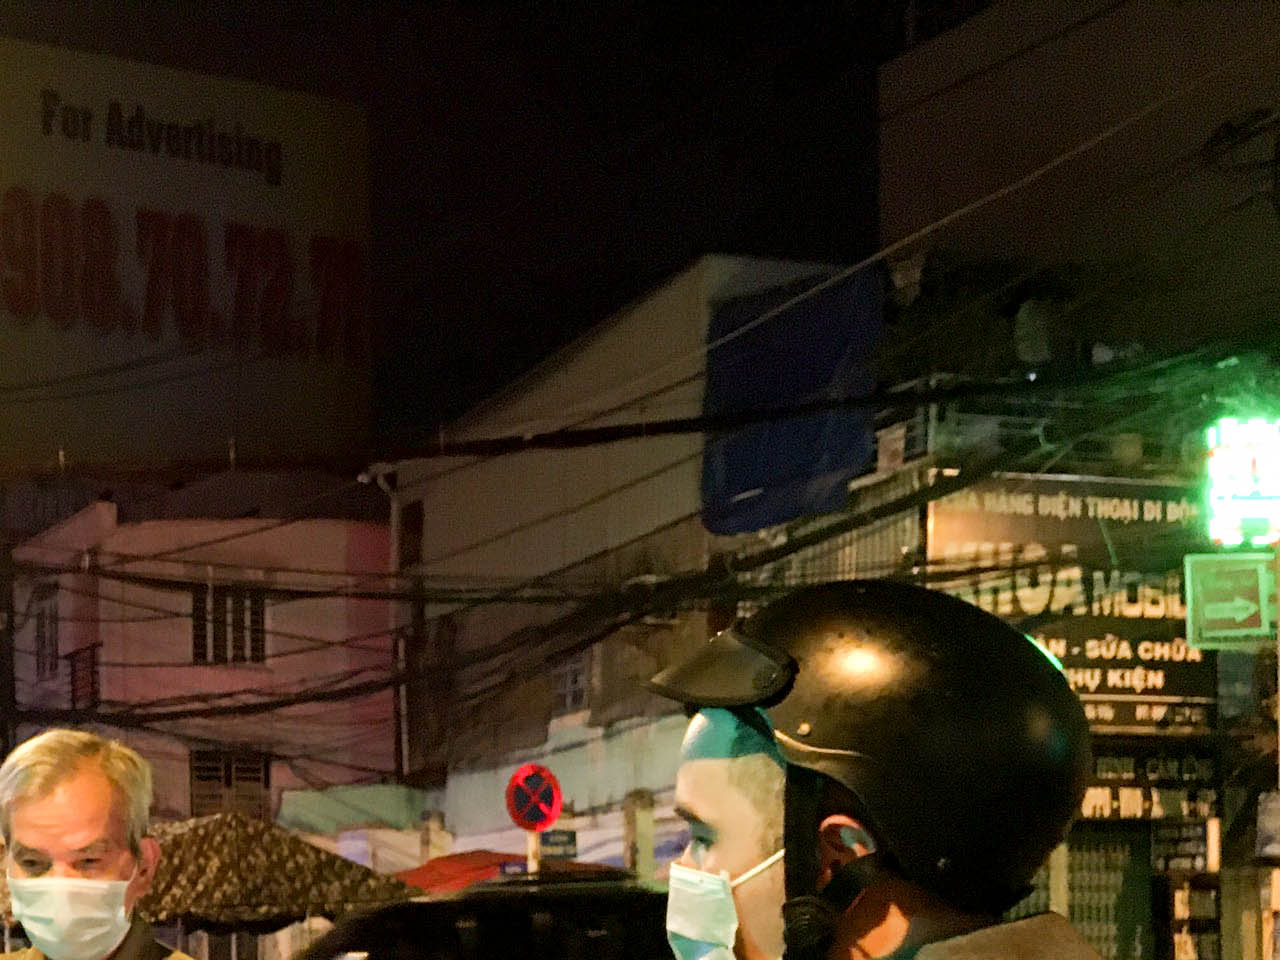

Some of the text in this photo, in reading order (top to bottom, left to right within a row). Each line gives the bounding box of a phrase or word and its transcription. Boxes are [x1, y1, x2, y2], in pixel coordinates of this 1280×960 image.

[40, 89, 283, 186] For Advertising
[1107, 665, 1164, 693] KIỆN
